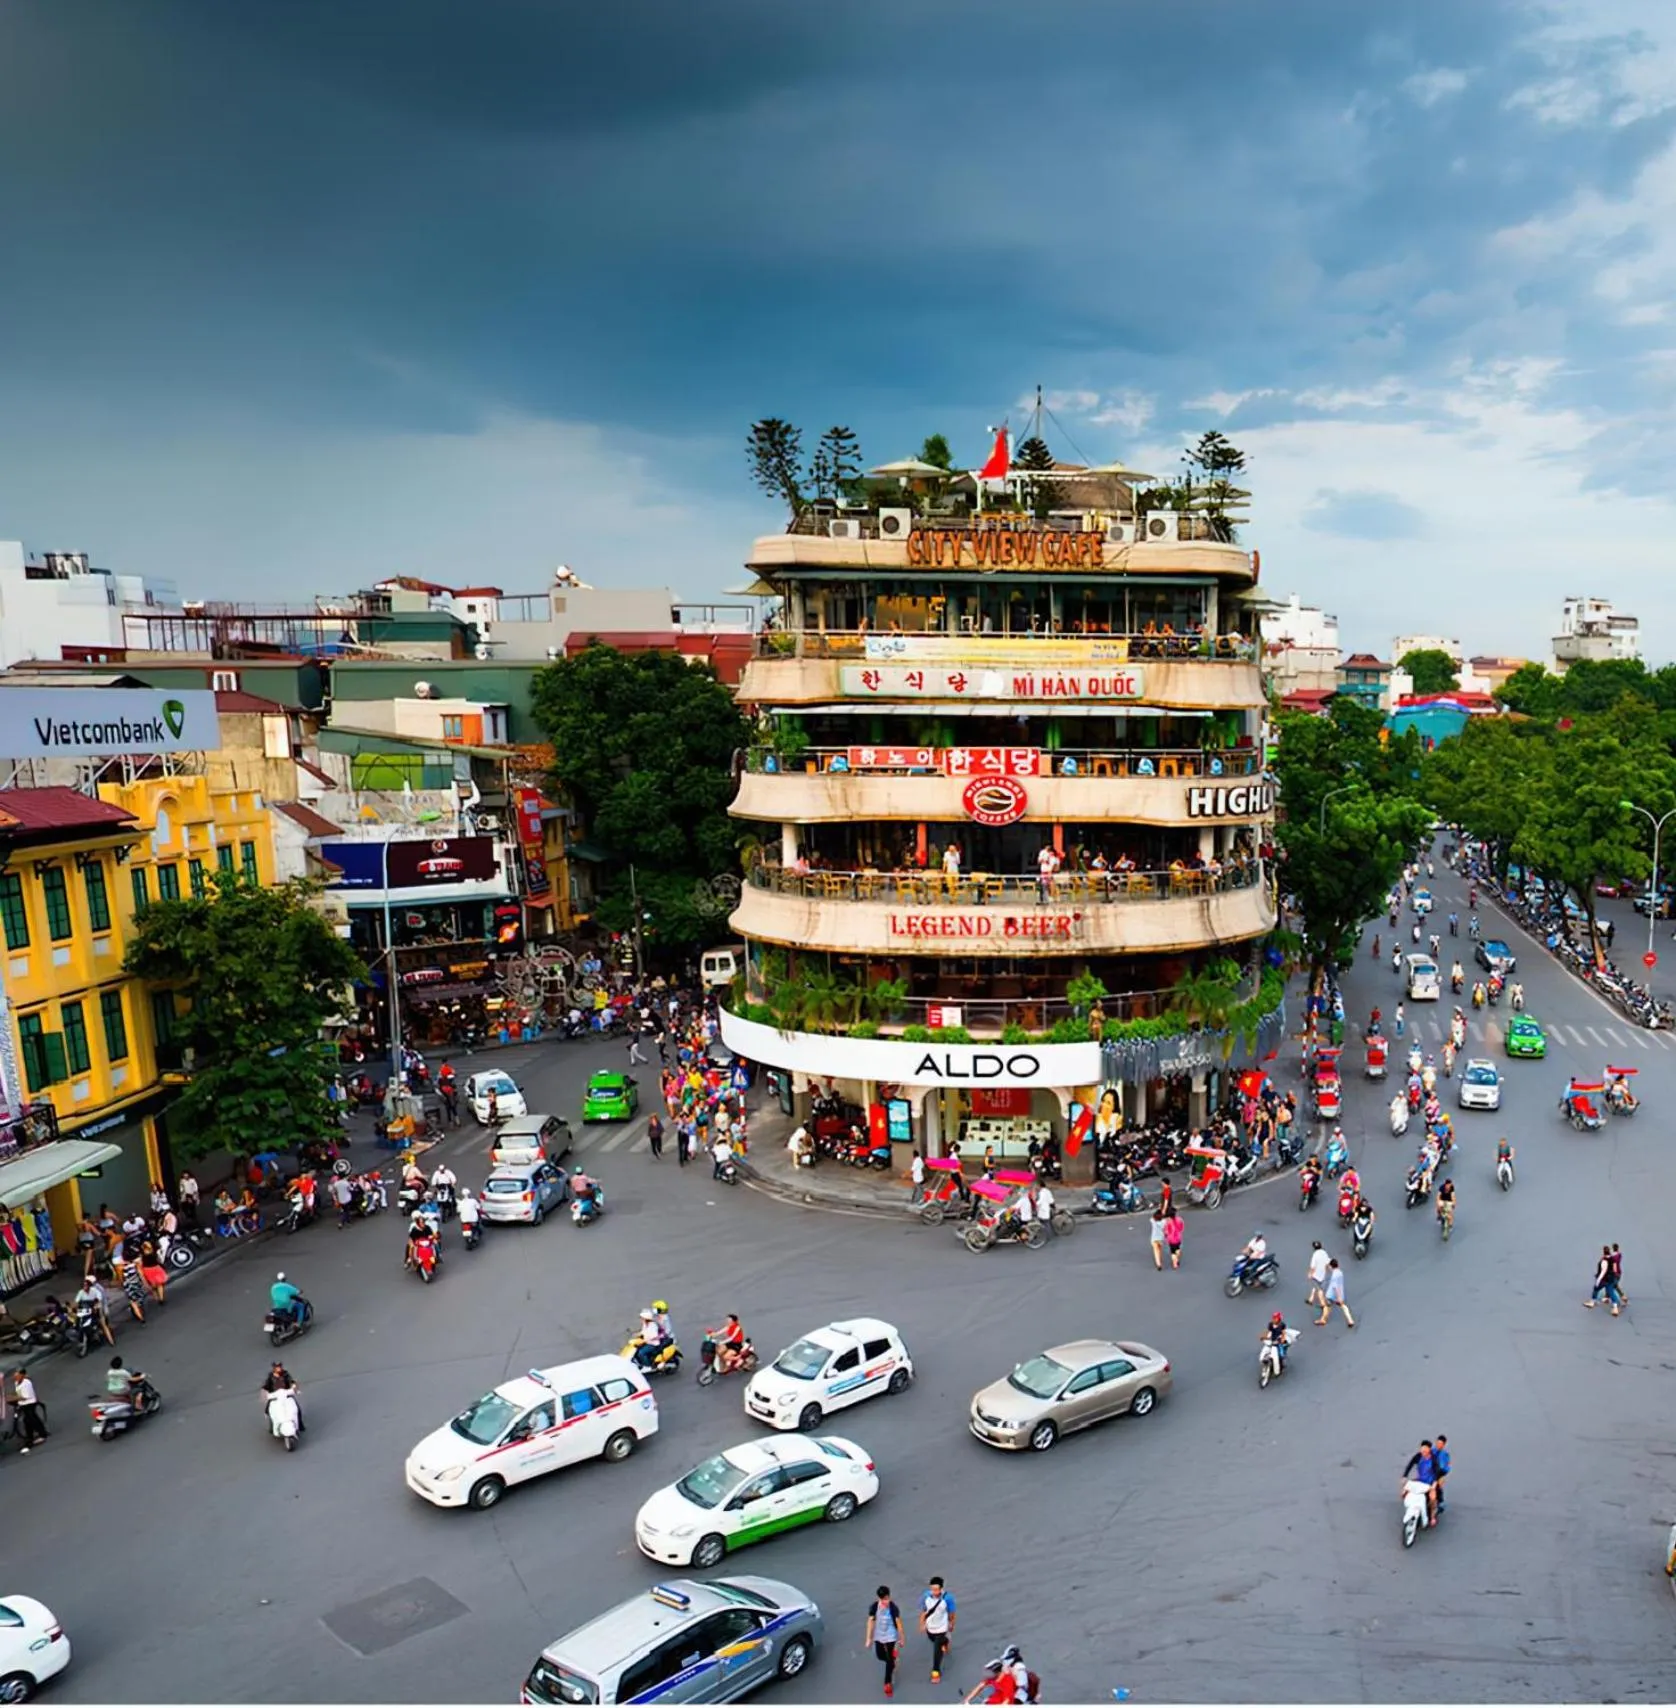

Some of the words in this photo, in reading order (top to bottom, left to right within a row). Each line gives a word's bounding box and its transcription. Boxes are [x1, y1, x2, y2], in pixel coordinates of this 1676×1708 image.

[907, 529, 963, 566] CITY
[972, 529, 1038, 566] VIEW
[1041, 529, 1105, 567] CAFE
[1042, 671, 1080, 695] HÀN
[1087, 670, 1135, 695] QUỐC
[34, 715, 165, 747] Vietcombank
[949, 748, 1037, 775] 한식당
[890, 914, 992, 937] LEGEND
[1003, 915, 1073, 938] BEER
[914, 1053, 1040, 1078] ALDO
